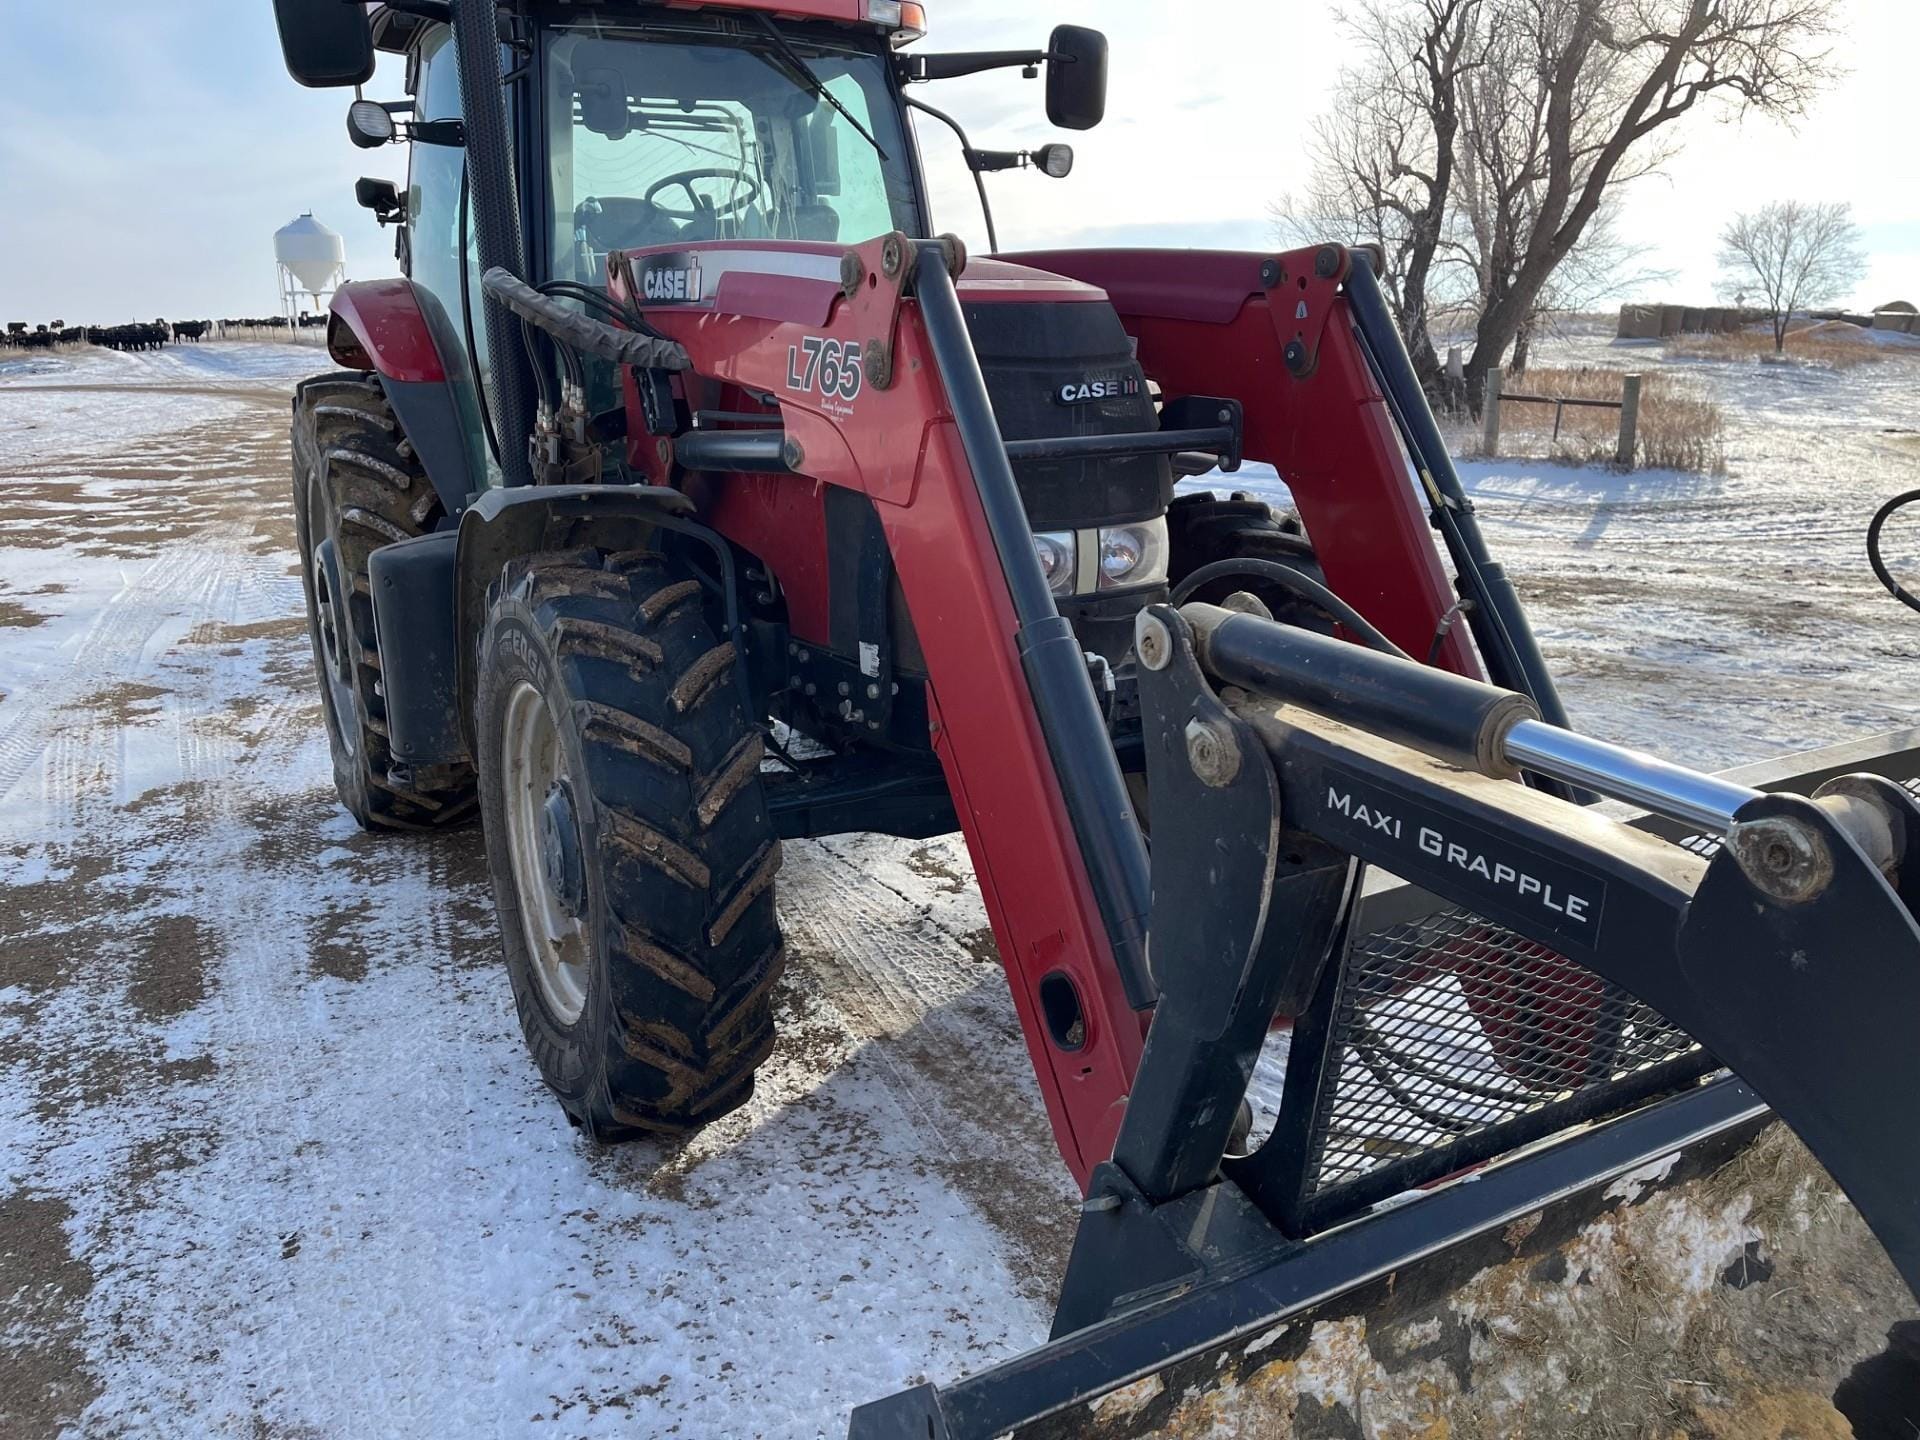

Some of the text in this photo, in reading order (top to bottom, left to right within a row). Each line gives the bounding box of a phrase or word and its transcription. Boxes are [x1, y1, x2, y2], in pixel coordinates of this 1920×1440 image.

[644, 268, 685, 299] CASE
[786, 335, 862, 401] L765
[1061, 382, 1118, 401] CASE
[1327, 787, 1590, 923] MAXI GRAPPLE
